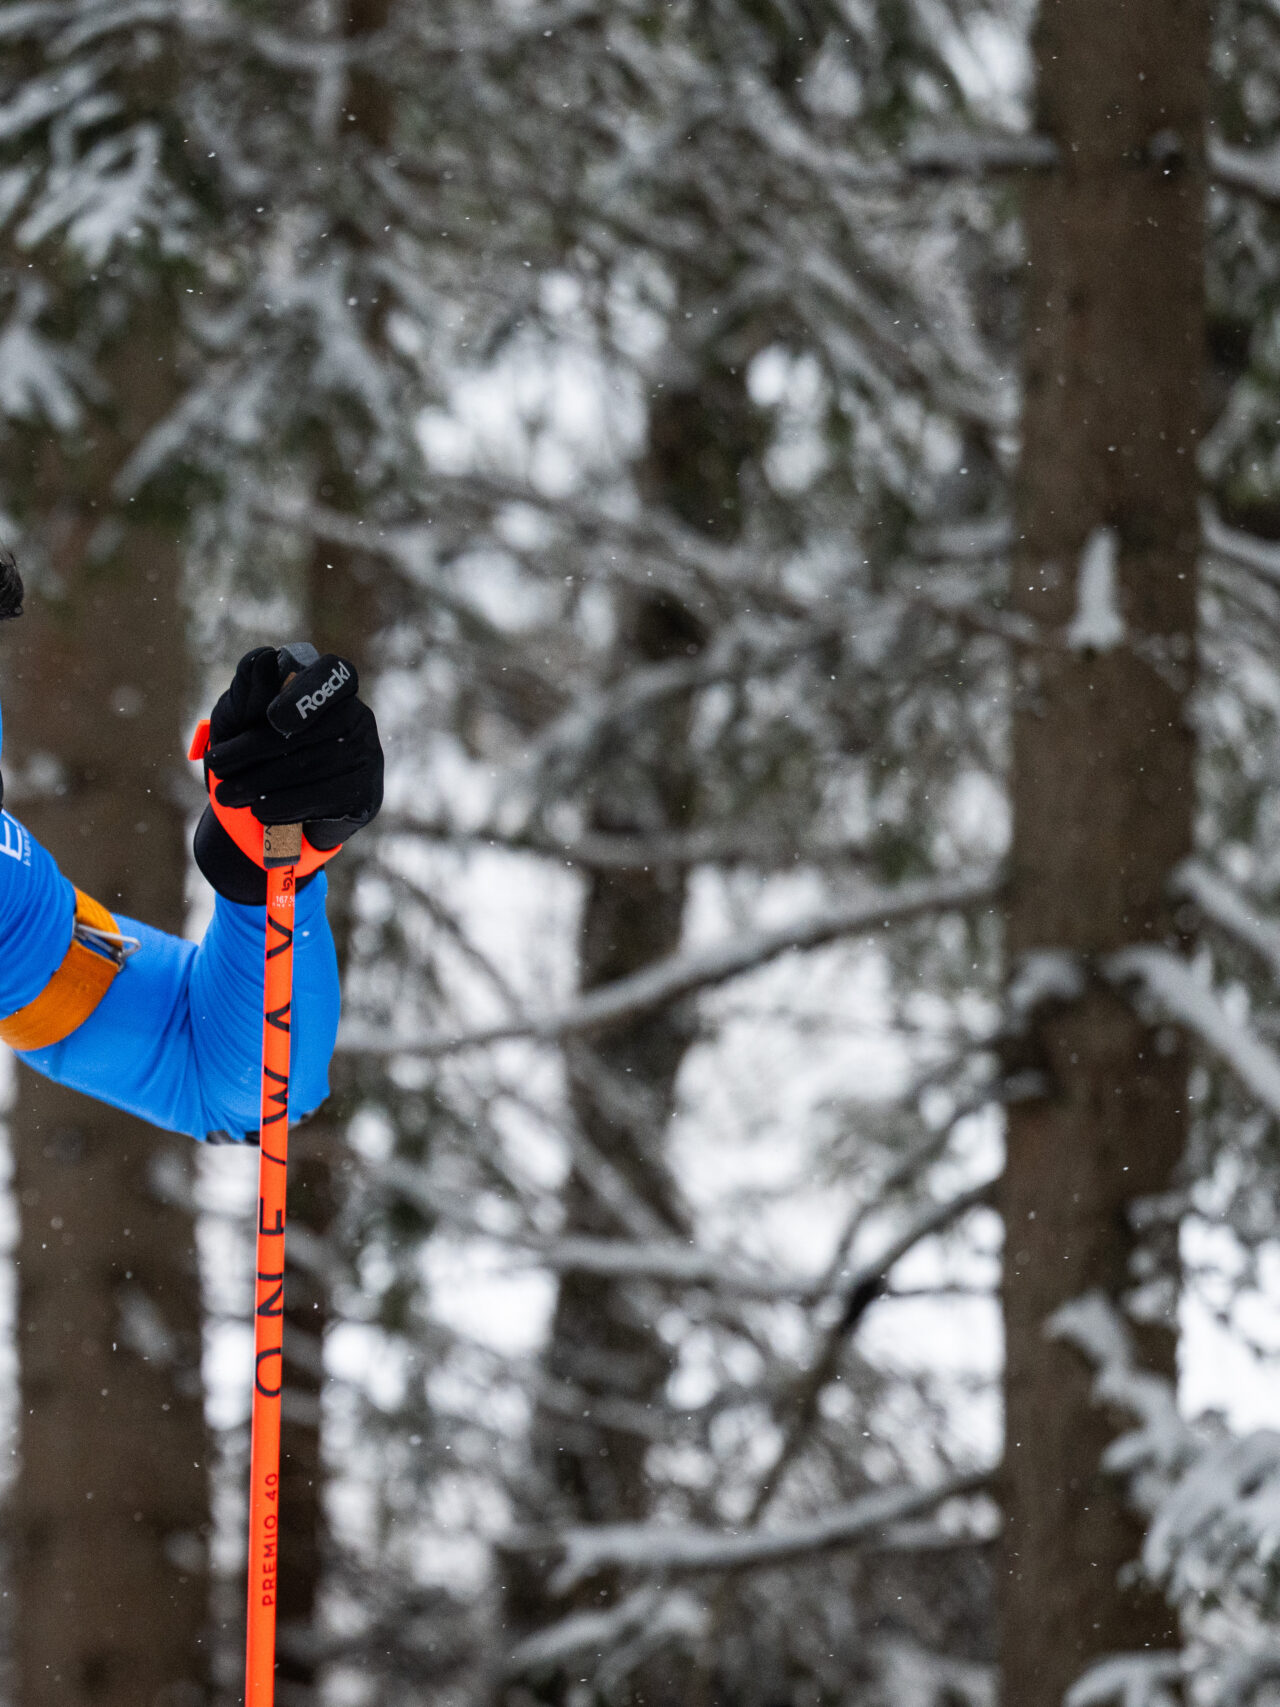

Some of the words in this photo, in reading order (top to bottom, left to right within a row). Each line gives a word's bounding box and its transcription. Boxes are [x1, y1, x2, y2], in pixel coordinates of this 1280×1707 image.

[296, 661, 350, 719] Roeckl
[265, 1473, 278, 1501] 40
[262, 1514, 278, 1606] PREMIO
